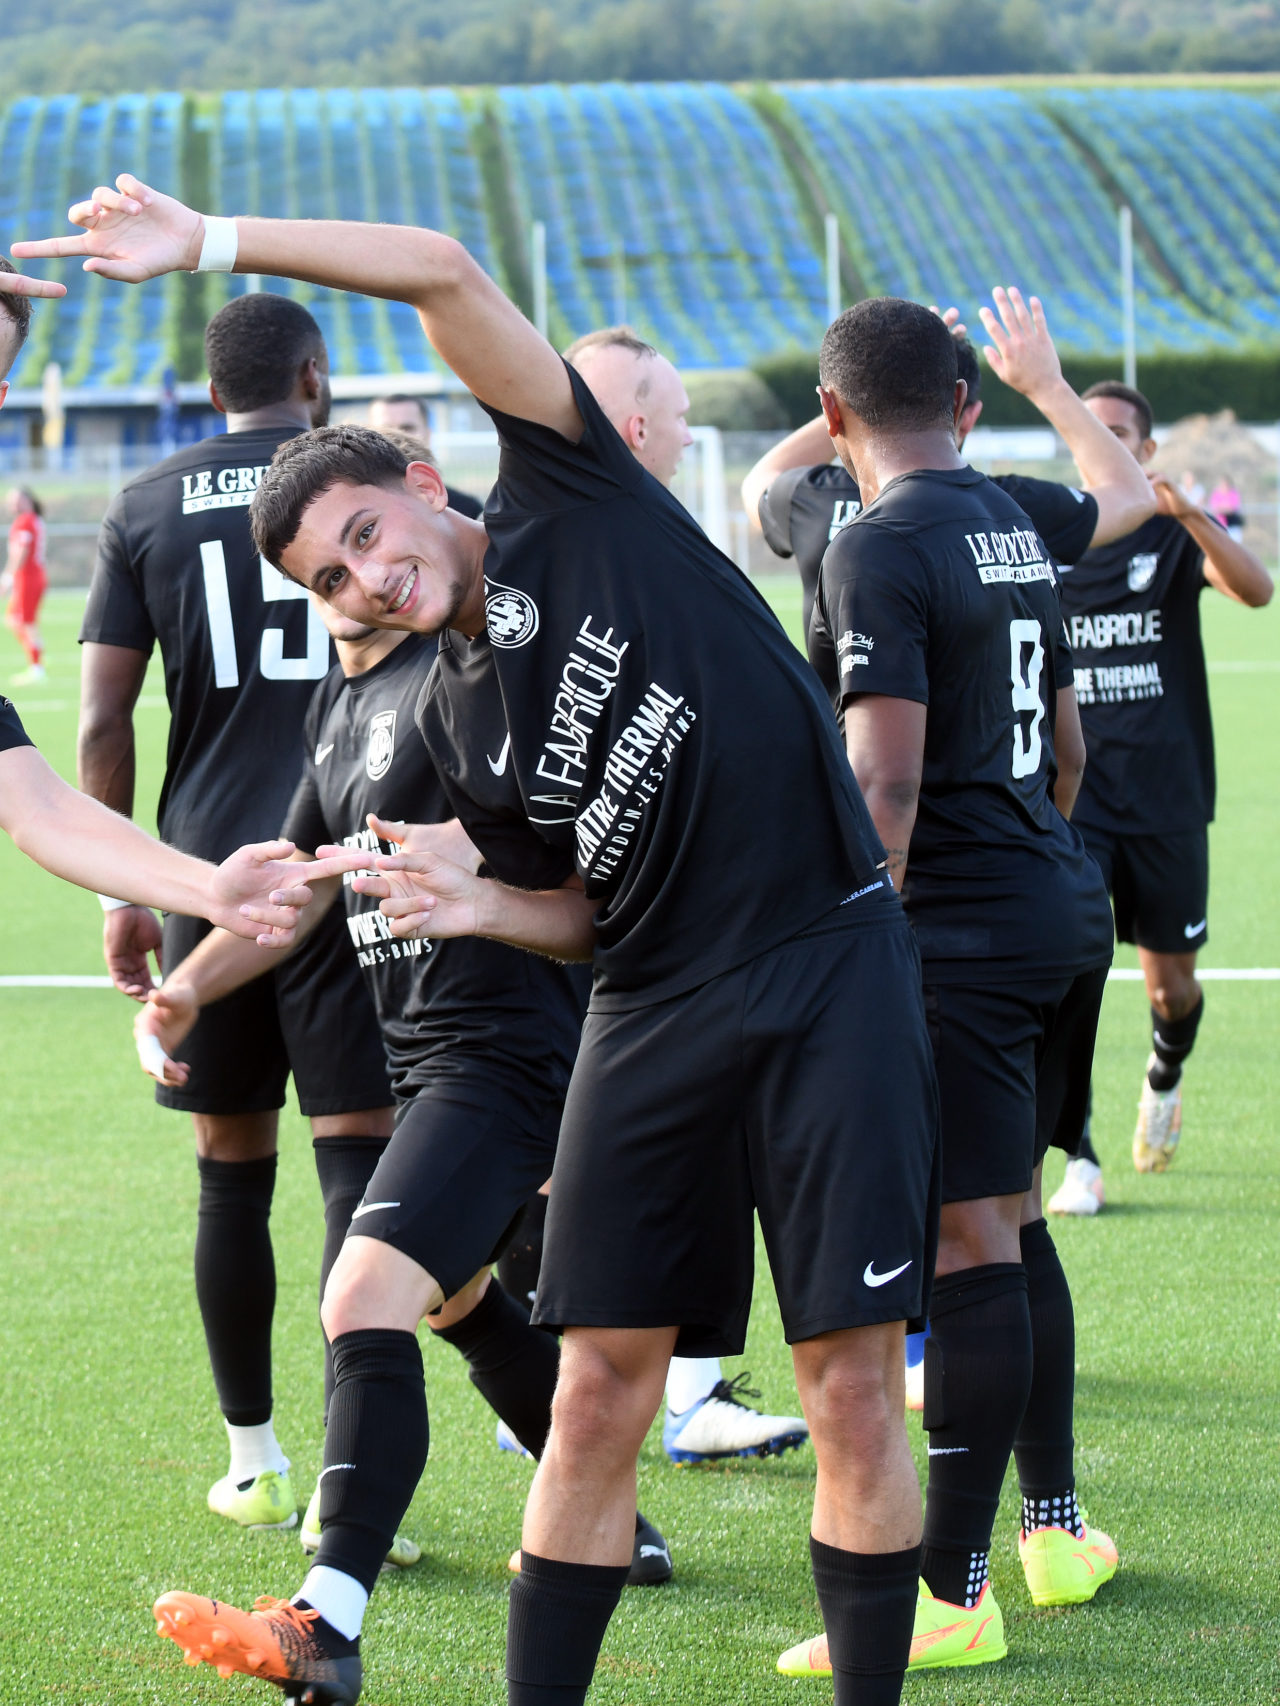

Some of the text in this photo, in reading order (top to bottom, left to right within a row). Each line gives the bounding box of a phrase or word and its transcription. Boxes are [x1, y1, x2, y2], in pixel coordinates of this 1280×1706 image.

[182, 471, 213, 500] LE
[964, 532, 996, 566] LE
[1070, 608, 1163, 650] FABRIQUE
[1094, 661, 1162, 690] THERMAL
[536, 615, 630, 788] FABRIQUE
[1010, 619, 1045, 779] 9
[603, 682, 685, 796] THERMAL
